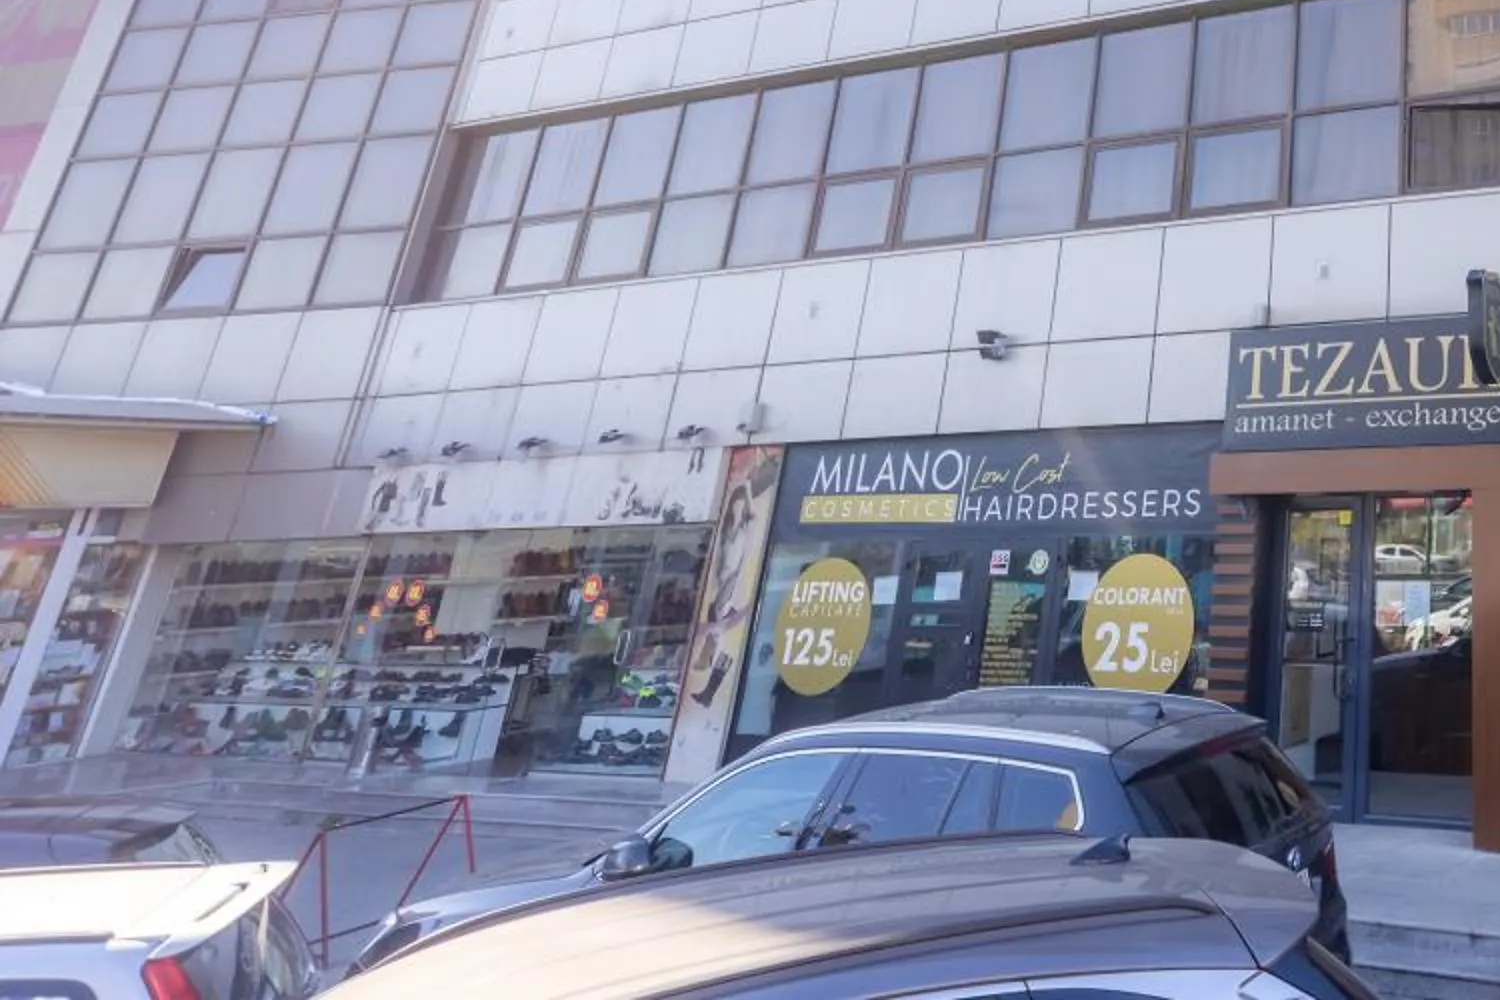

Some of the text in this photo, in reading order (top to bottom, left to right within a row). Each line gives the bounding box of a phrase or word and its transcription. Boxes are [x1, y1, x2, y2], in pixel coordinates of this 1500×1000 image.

[1235, 409, 1336, 433] amanet
[810, 449, 1071, 493] MILANO Low Cost
[804, 489, 1201, 521] COSMETICS HAIRDRESSERS
[792, 581, 865, 603] LIFTING
[1093, 587, 1187, 606] COLORANT
[782, 628, 853, 668] 125 Lei
[1090, 621, 1180, 674] 25 Lei
